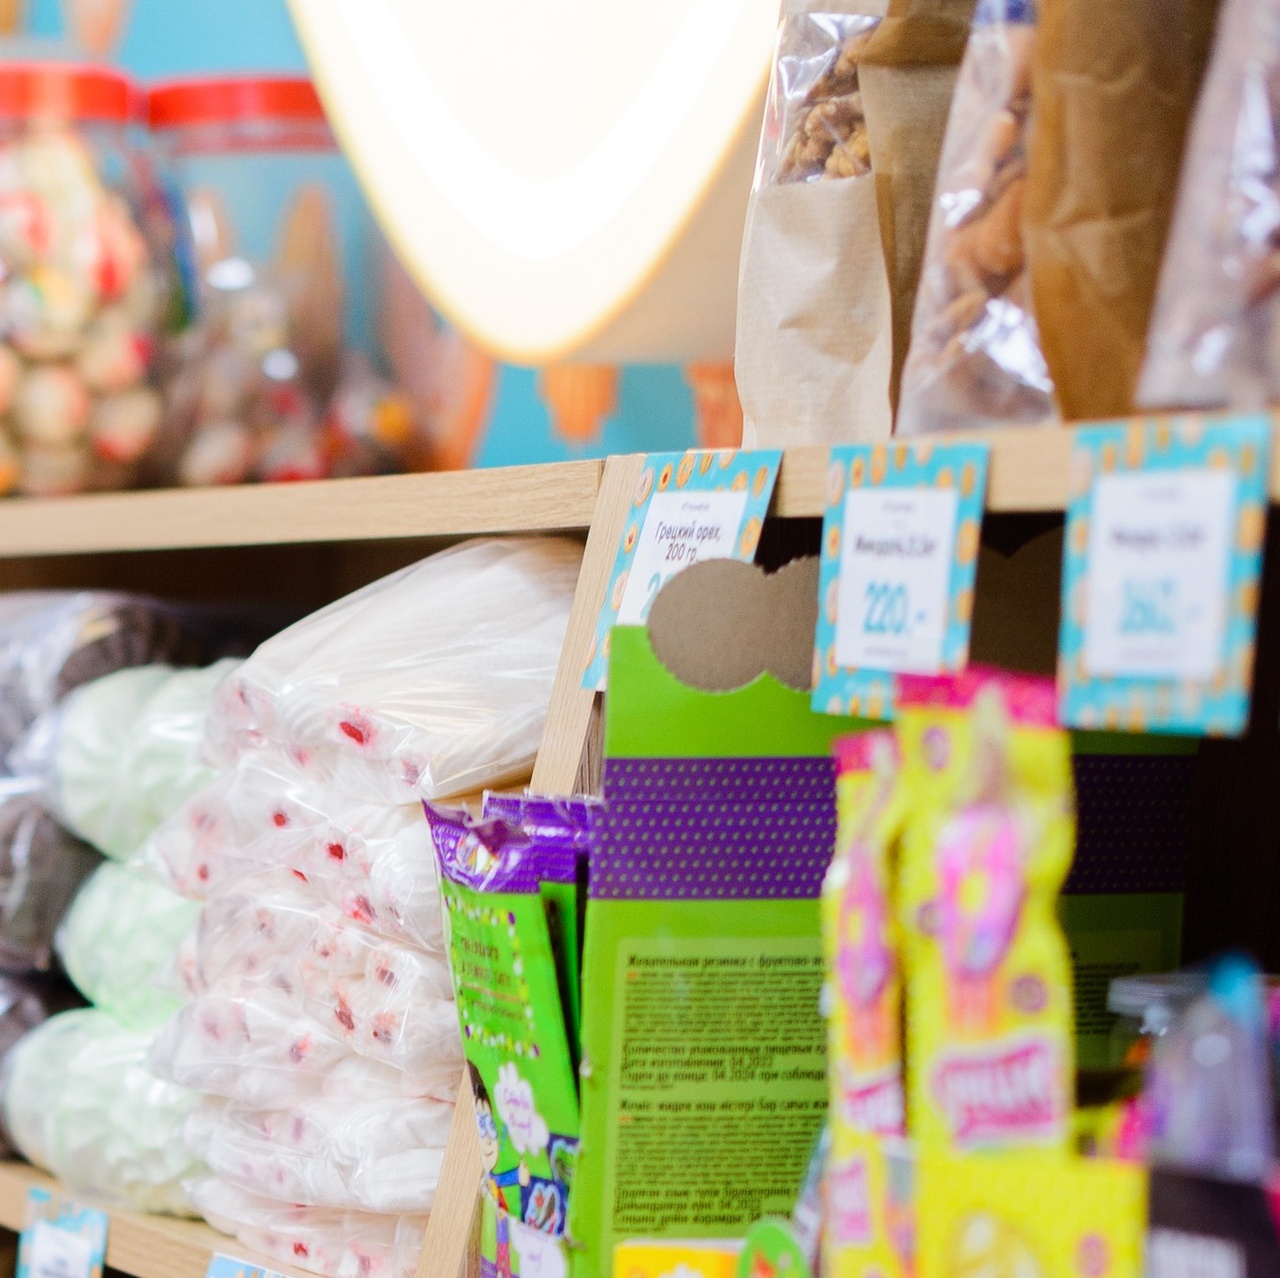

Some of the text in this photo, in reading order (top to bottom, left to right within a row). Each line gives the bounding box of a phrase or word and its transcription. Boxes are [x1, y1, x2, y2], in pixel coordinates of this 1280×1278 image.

[654, 520, 723, 545] Грецкий орех,
[665, 542, 686, 561] 200
